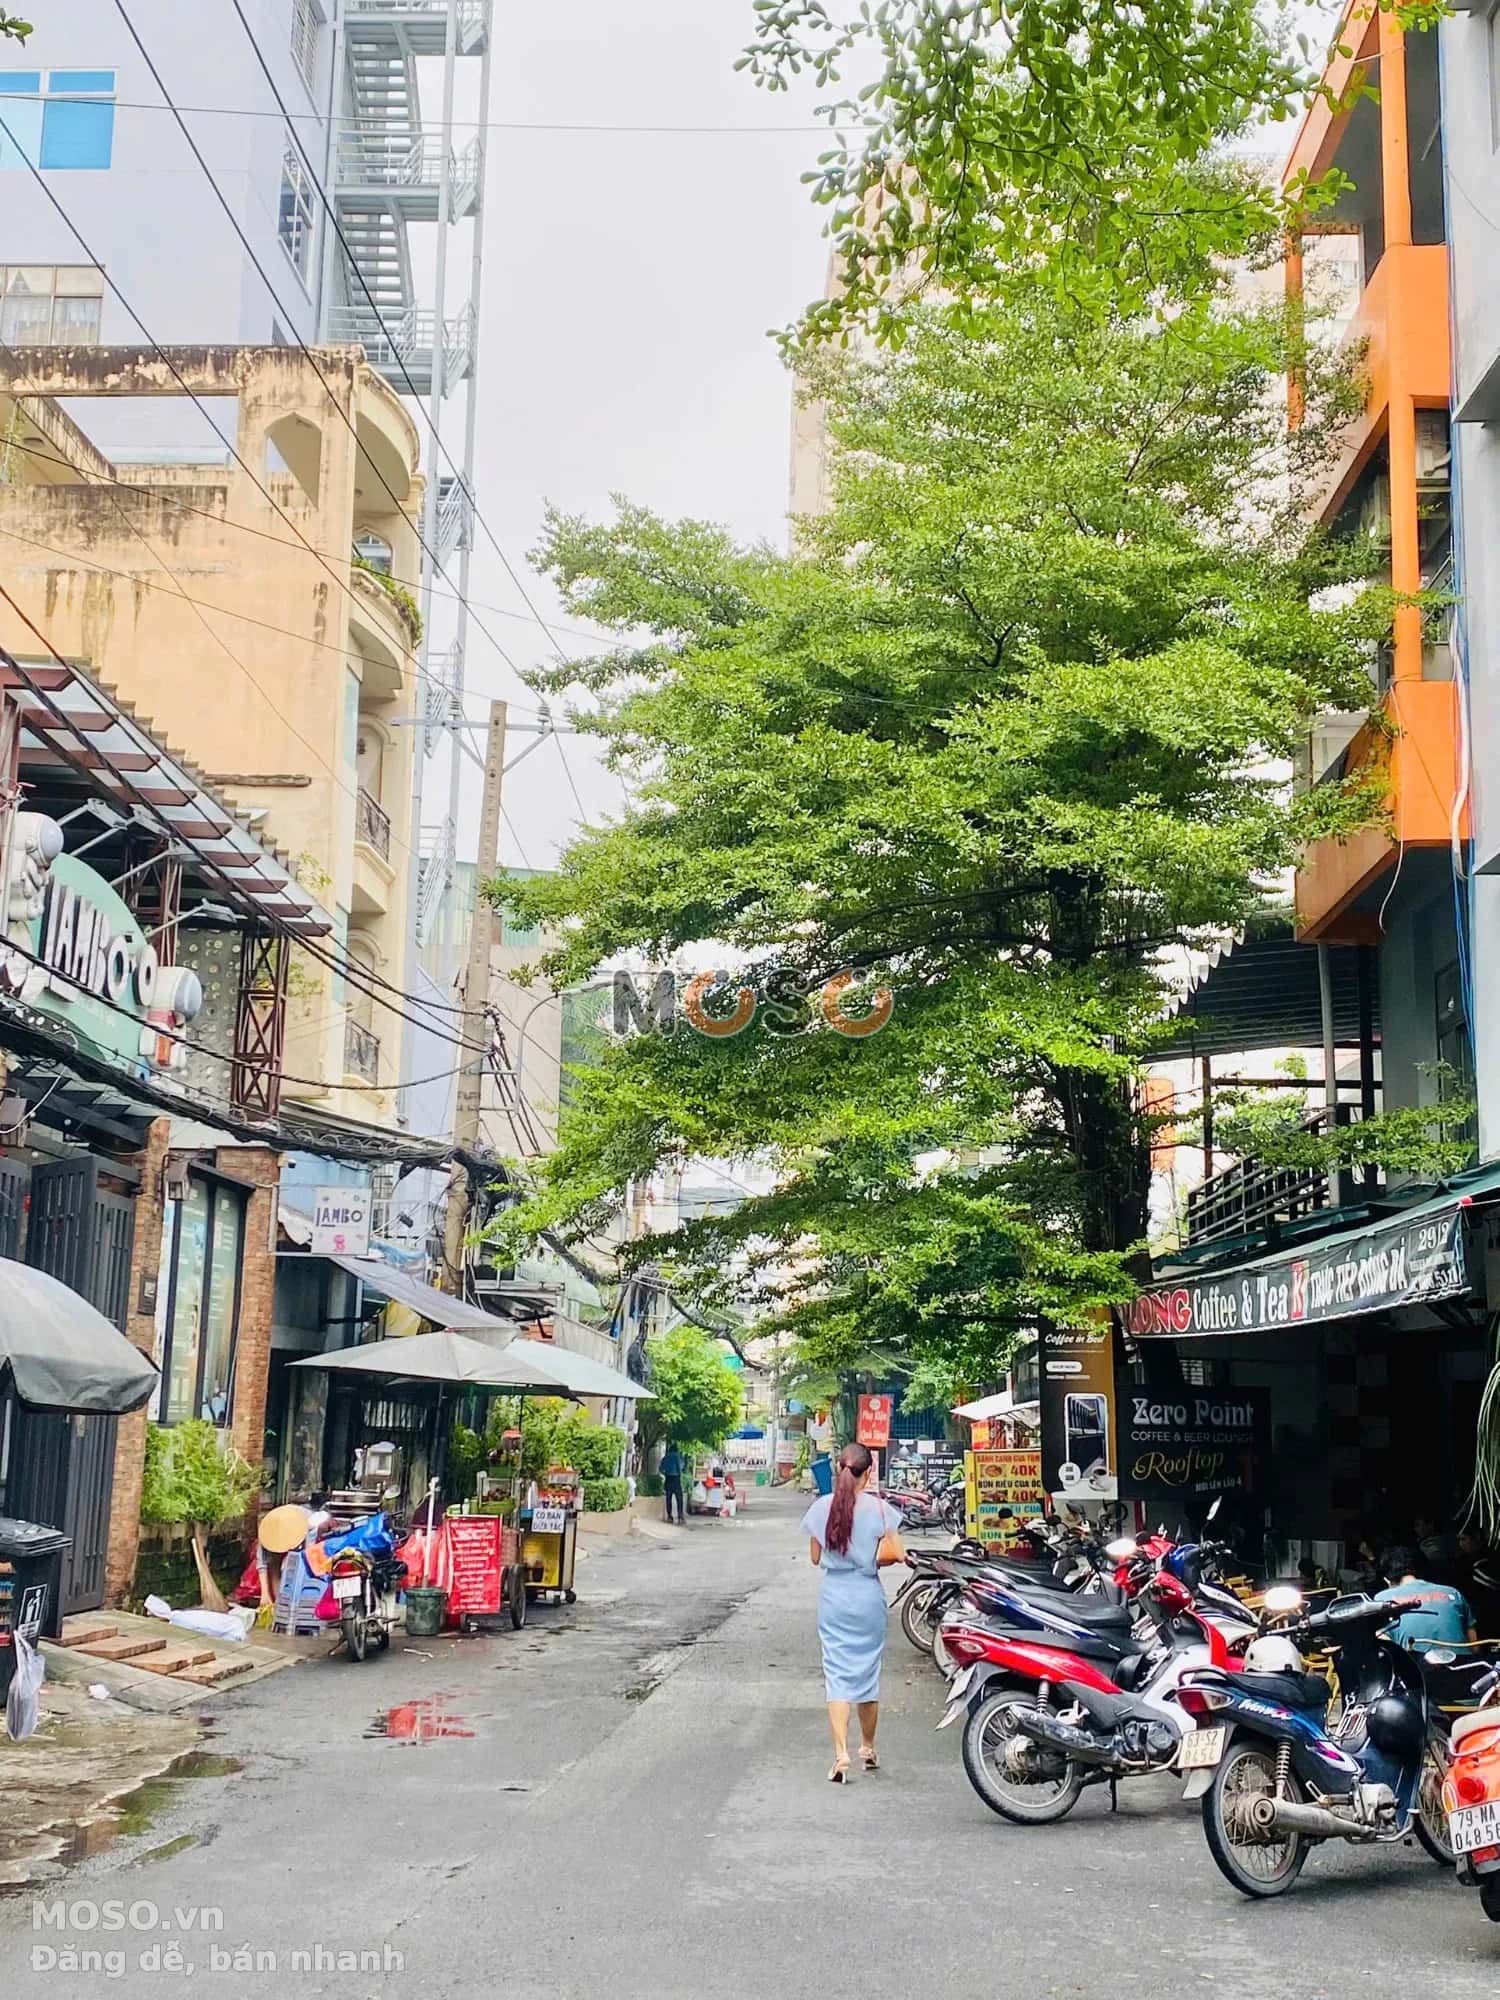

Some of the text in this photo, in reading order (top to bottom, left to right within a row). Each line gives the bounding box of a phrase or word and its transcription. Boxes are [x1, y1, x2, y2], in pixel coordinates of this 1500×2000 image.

[1418, 1222, 1449, 1251] 29/2
[1193, 1286, 1237, 1331] Coffee
[1241, 1279, 1253, 1326] &
[1257, 1276, 1288, 1324] Tea
[1131, 1398, 1254, 1426] Zero Point
[1131, 1431, 1171, 1441] COFFEE
[1184, 1431, 1209, 1442] BEER
[1011, 1465, 1037, 1476] 40K
[1132, 1446, 1224, 1486] Rooftop
[1012, 1490, 1038, 1502] 40K
[1458, 1804, 1496, 1829] 79-NA
